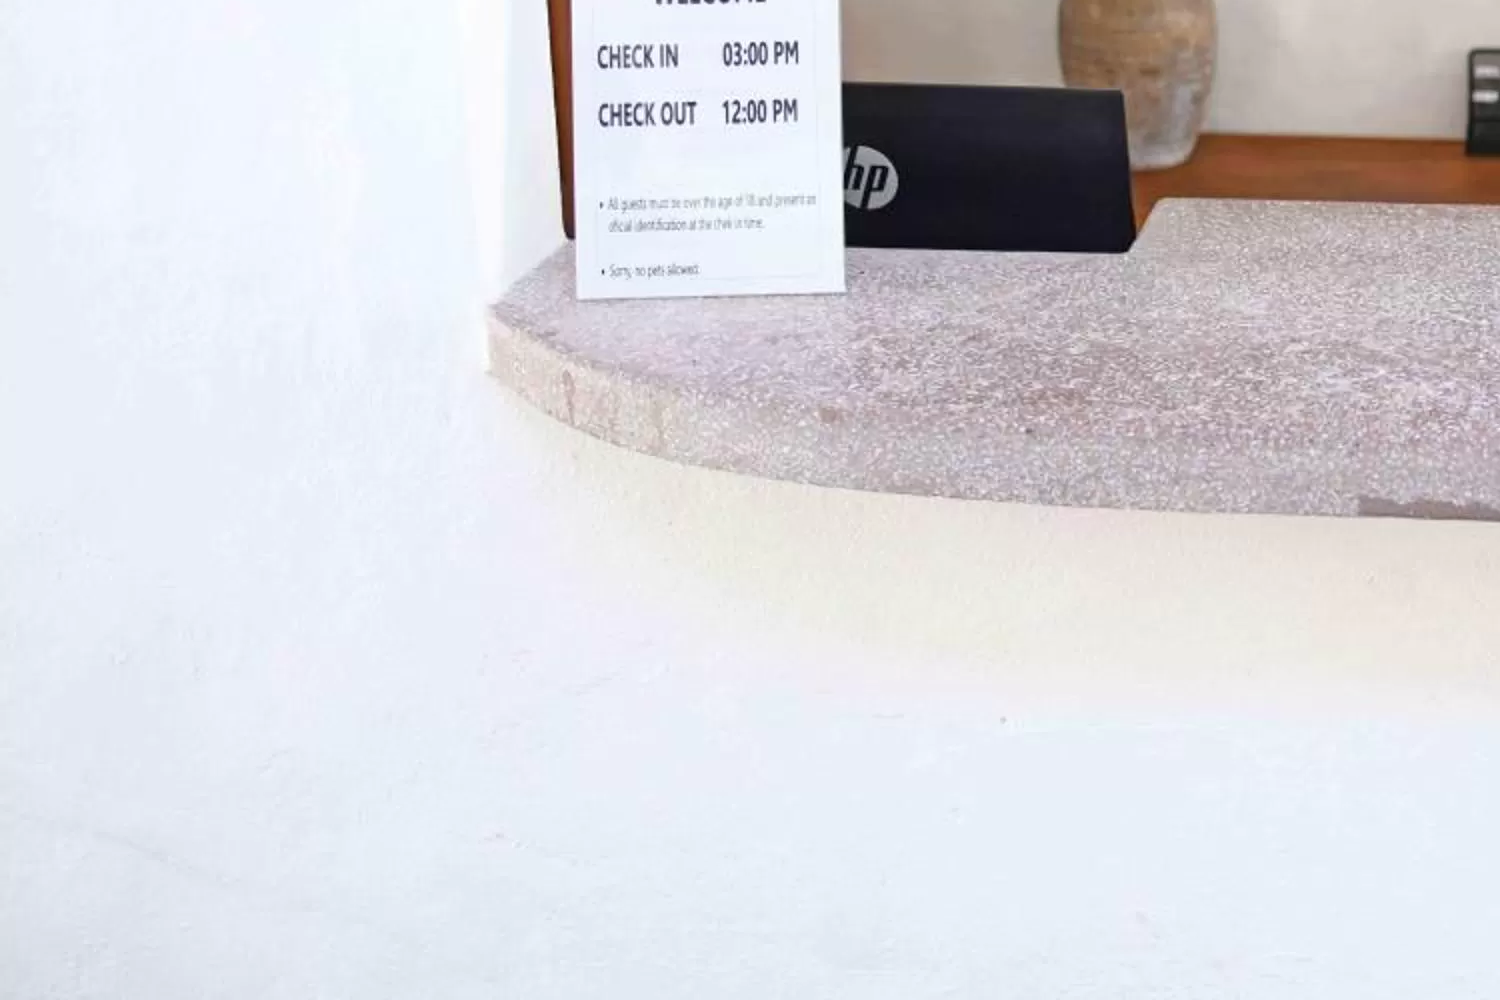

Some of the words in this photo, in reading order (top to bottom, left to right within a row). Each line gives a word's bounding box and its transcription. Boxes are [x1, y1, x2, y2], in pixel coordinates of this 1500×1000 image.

[597, 45, 655, 69] CHECK
[659, 44, 679, 68] IN
[722, 42, 768, 66] 03:00
[773, 40, 799, 64] PM
[598, 103, 656, 127] CHECK
[660, 102, 697, 125] OUT
[722, 100, 767, 124] 12:00
[772, 98, 798, 122] PM
[844, 145, 889, 208] hp
[621, 198, 647, 213] guests
